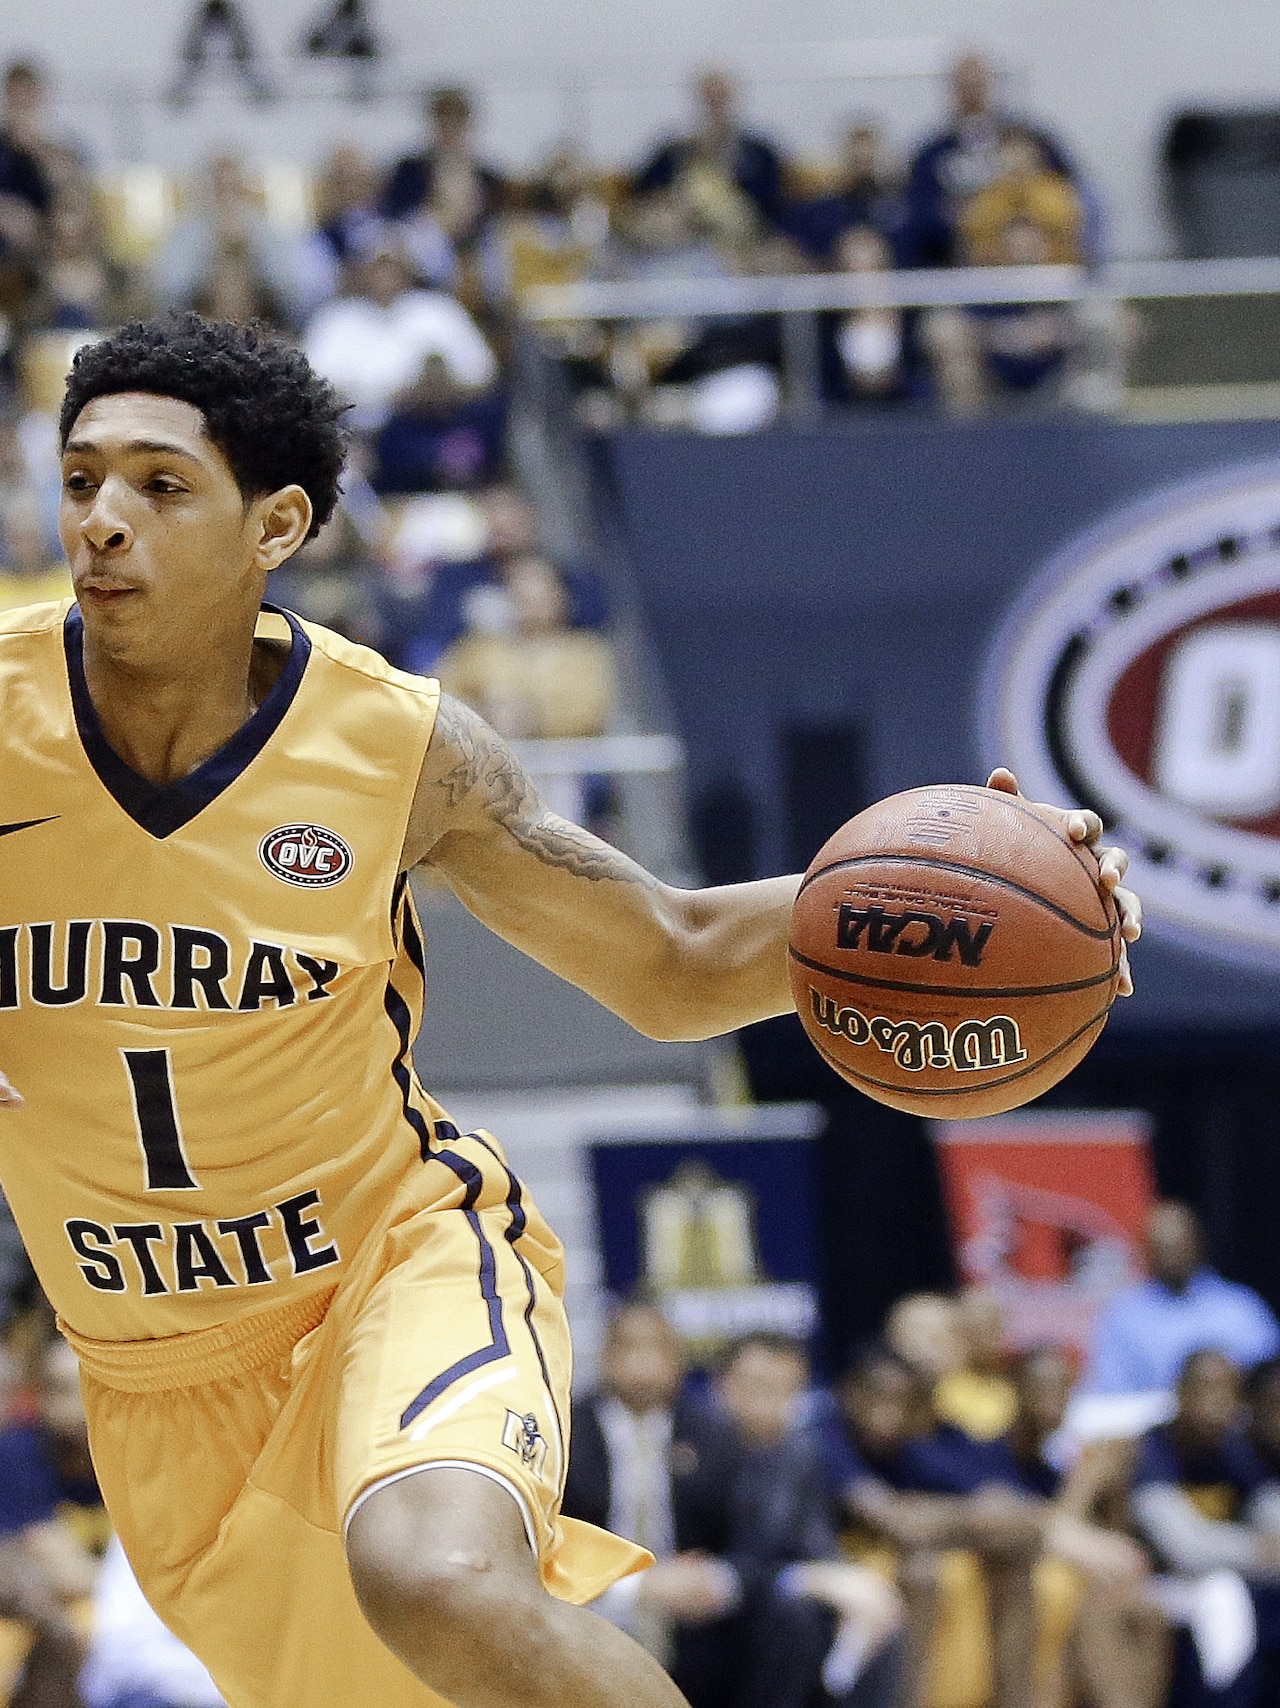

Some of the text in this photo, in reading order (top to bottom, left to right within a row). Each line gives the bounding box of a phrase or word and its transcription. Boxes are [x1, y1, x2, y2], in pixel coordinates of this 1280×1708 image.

[278, 842, 335, 872] OVC
[836, 902, 995, 968] NCAA
[810, 986, 1027, 1072] Wilson
[119, 1046, 204, 1192] 1
[64, 1189, 343, 1298] STATE
